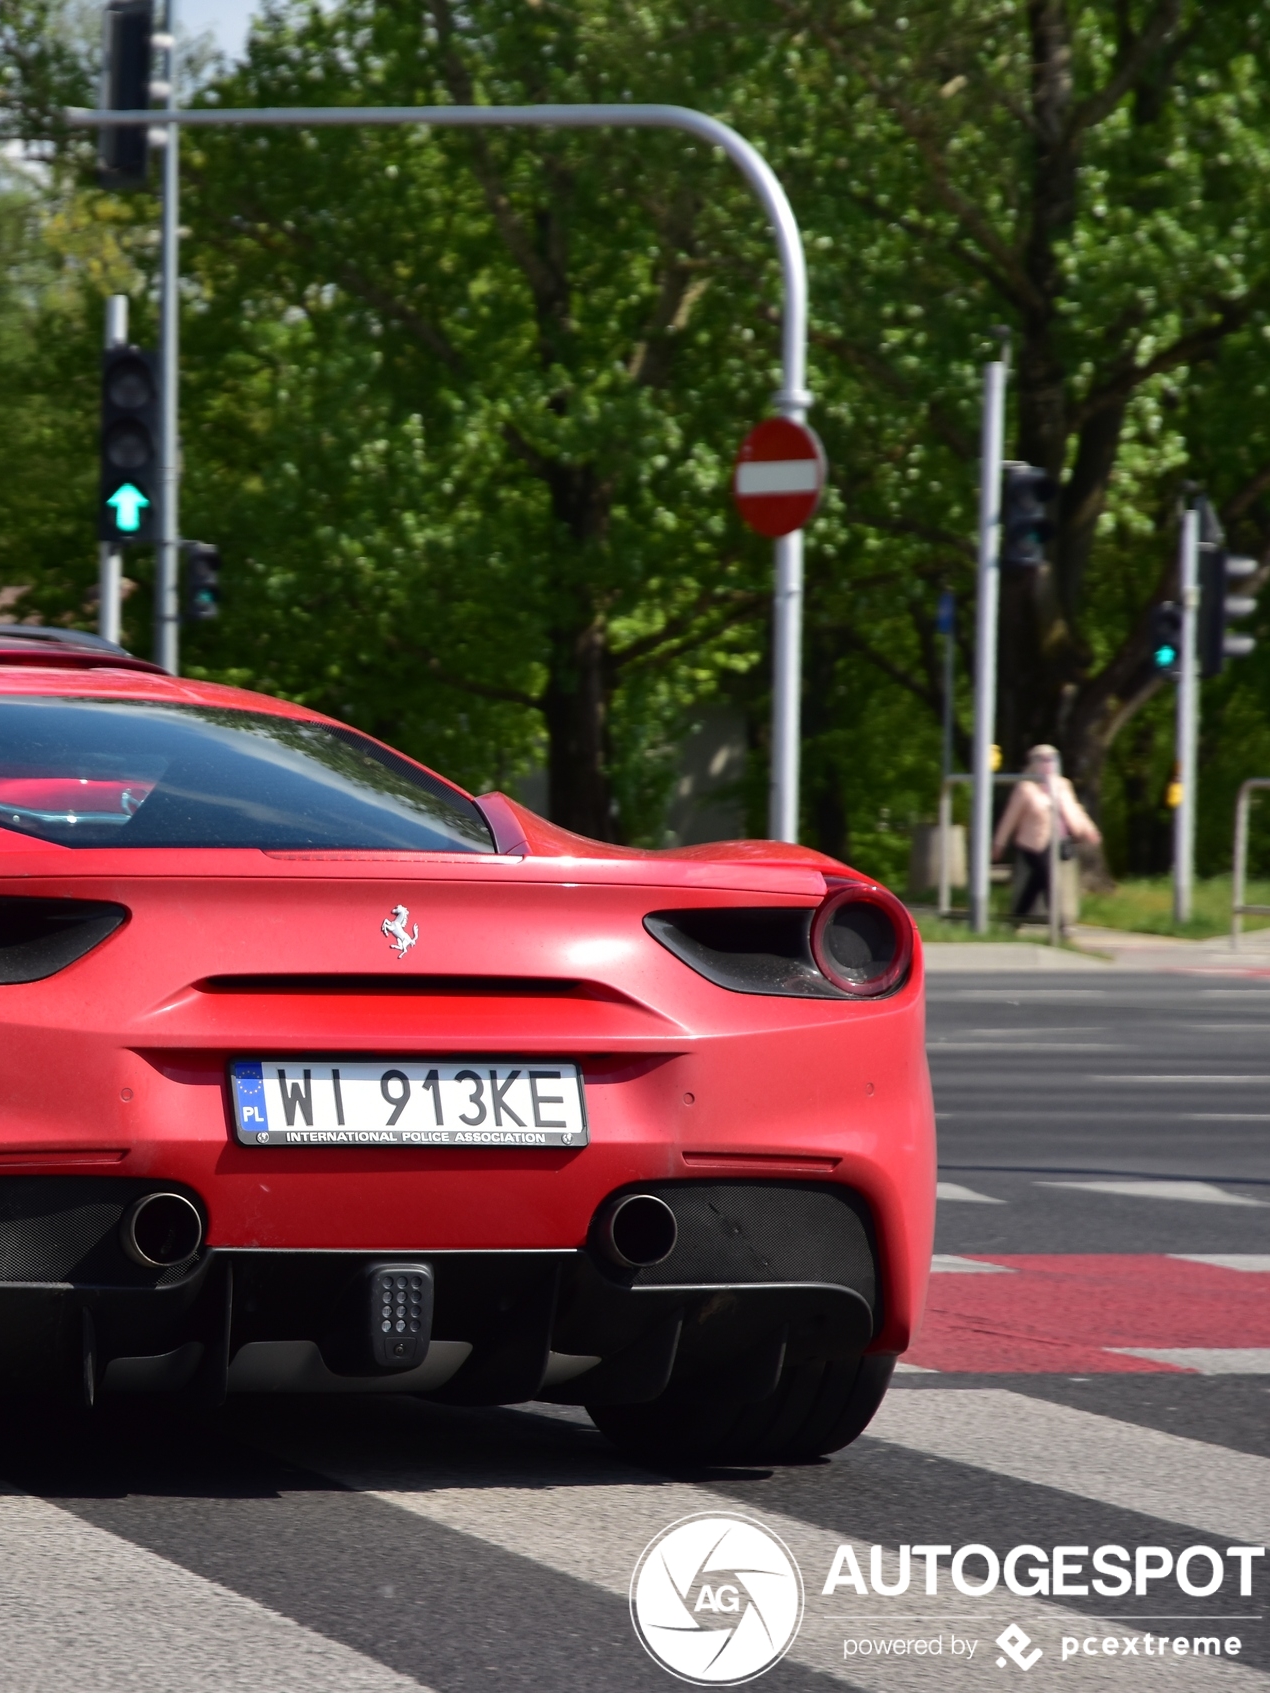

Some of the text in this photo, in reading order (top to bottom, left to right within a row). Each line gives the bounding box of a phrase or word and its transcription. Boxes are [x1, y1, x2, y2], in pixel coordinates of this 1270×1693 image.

[277, 1068, 568, 1128] WI 913KE
[242, 1106, 265, 1123] PL
[286, 1132, 546, 1144] INTERNATIONAL POLICE ASSOCIATION
